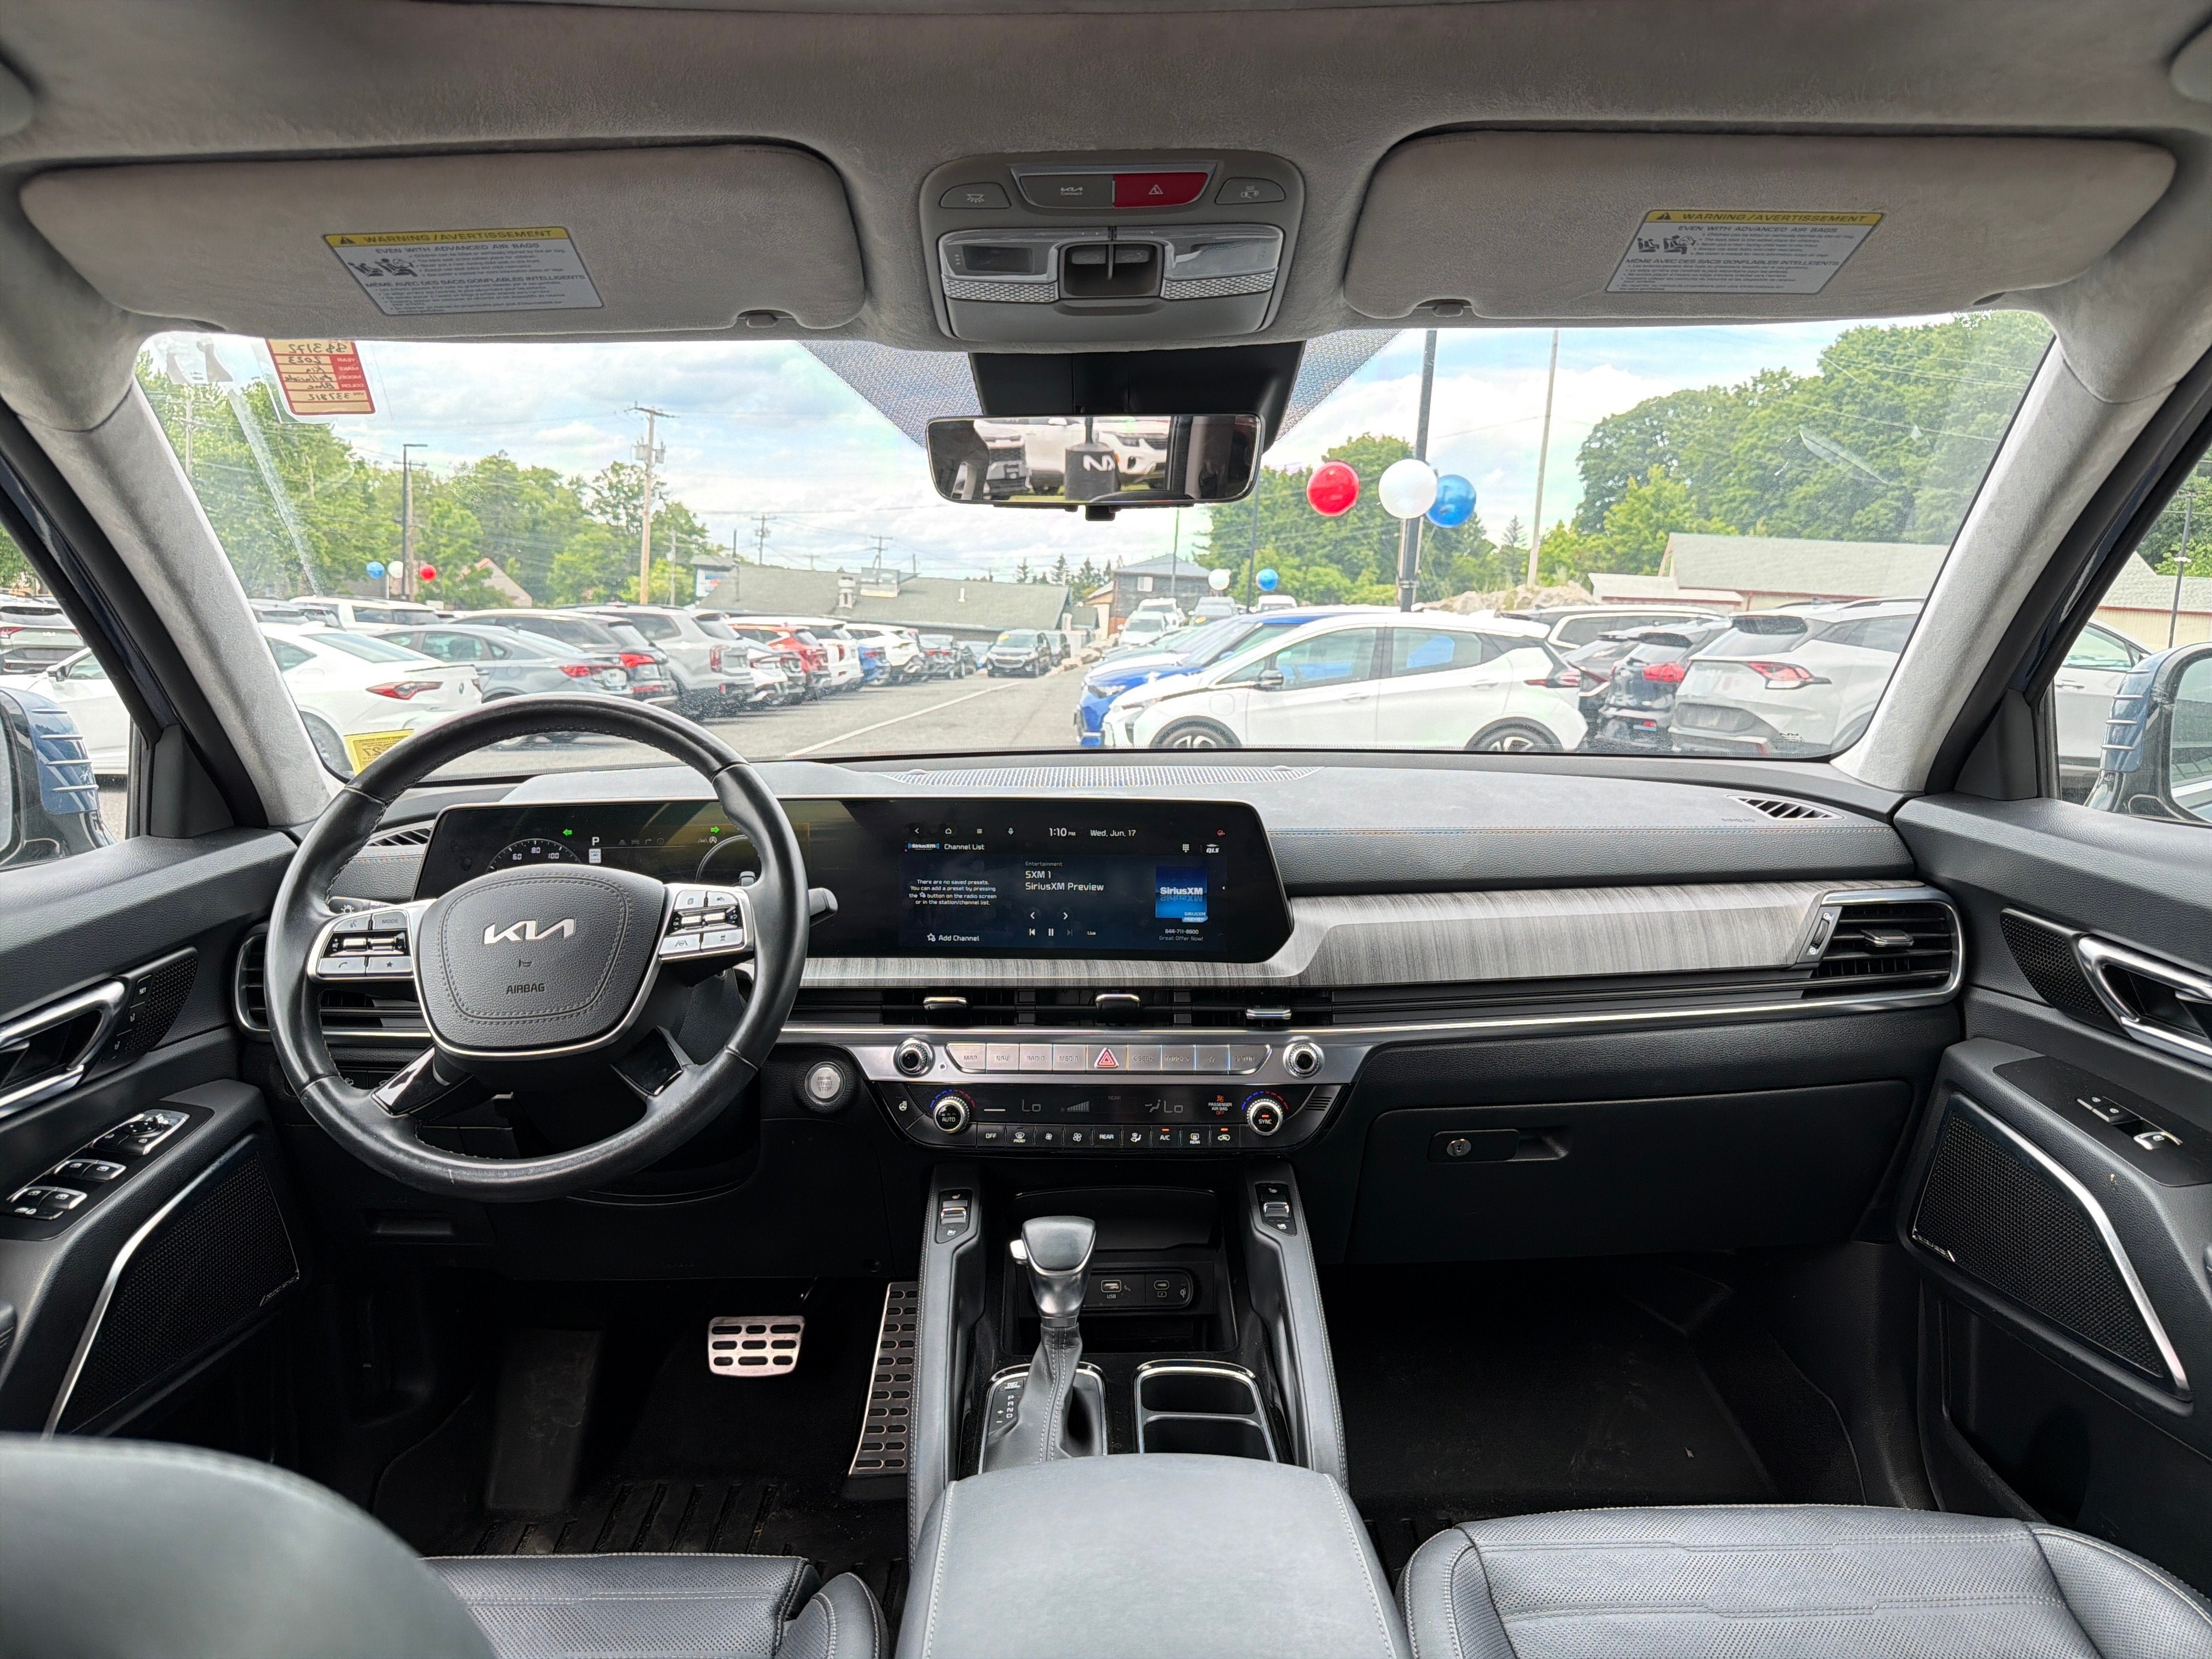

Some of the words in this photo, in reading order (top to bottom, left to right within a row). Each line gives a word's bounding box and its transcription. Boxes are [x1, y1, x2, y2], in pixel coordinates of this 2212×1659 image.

[363, 235, 431, 243] WARNING
[1049, 828, 1067, 837] 1:10
[592, 837, 600, 846] P
[1025, 871, 1045, 879] SXM
[1025, 882, 1065, 891] SiriusXM
[1068, 883, 1104, 891] Preview
[1160, 887, 1203, 895] SiriusXM
[483, 918, 574, 944] KIA
[506, 983, 545, 995] AIRBAG
